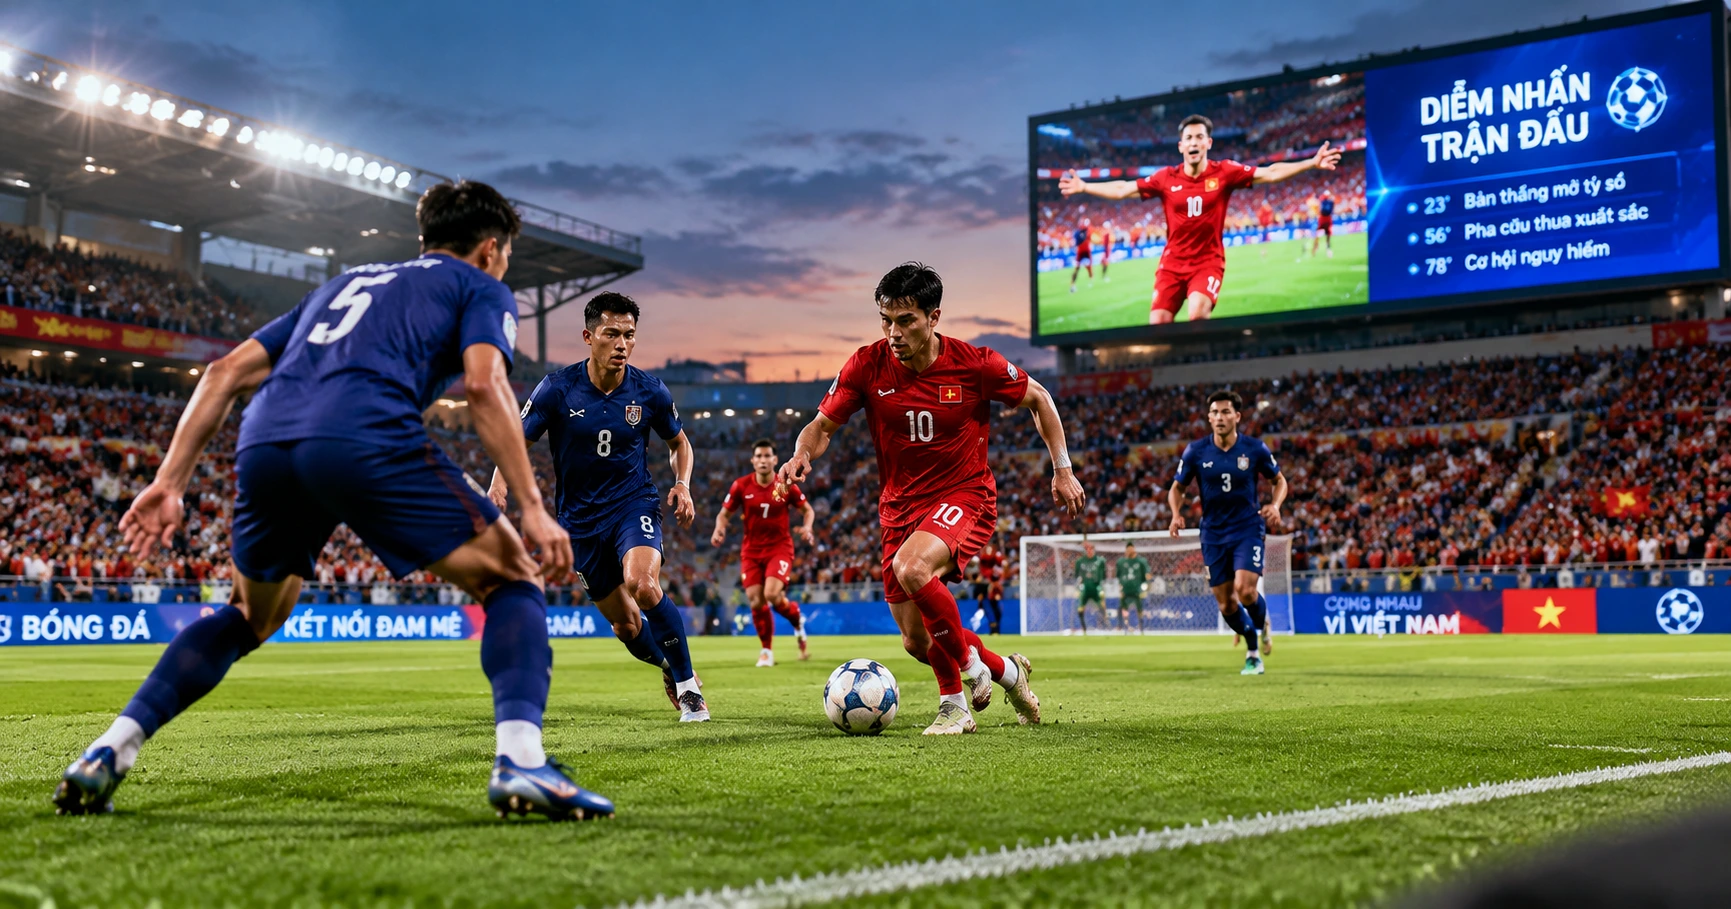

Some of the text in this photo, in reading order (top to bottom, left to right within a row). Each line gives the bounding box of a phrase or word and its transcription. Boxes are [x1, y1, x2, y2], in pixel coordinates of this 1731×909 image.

[1420, 120, 1509, 164] TRẬN
[1186, 195, 1203, 218] 10
[1464, 222, 1497, 241] Pha
[1533, 214, 1572, 232] thua
[1520, 246, 1563, 268] nguy
[307, 271, 398, 345] 5
[905, 410, 934, 443] 10
[596, 429, 612, 457] 8
[1221, 472, 1232, 493] 3
[760, 503, 770, 519] 7
[932, 503, 964, 526] 10
[640, 515, 654, 533] 8
[1252, 545, 1261, 562] 3
[22, 607, 104, 641] BÓNG
[109, 608, 151, 640] ĐÁ
[375, 615, 426, 638] ĐAM
[1405, 614, 1460, 635] NAM
